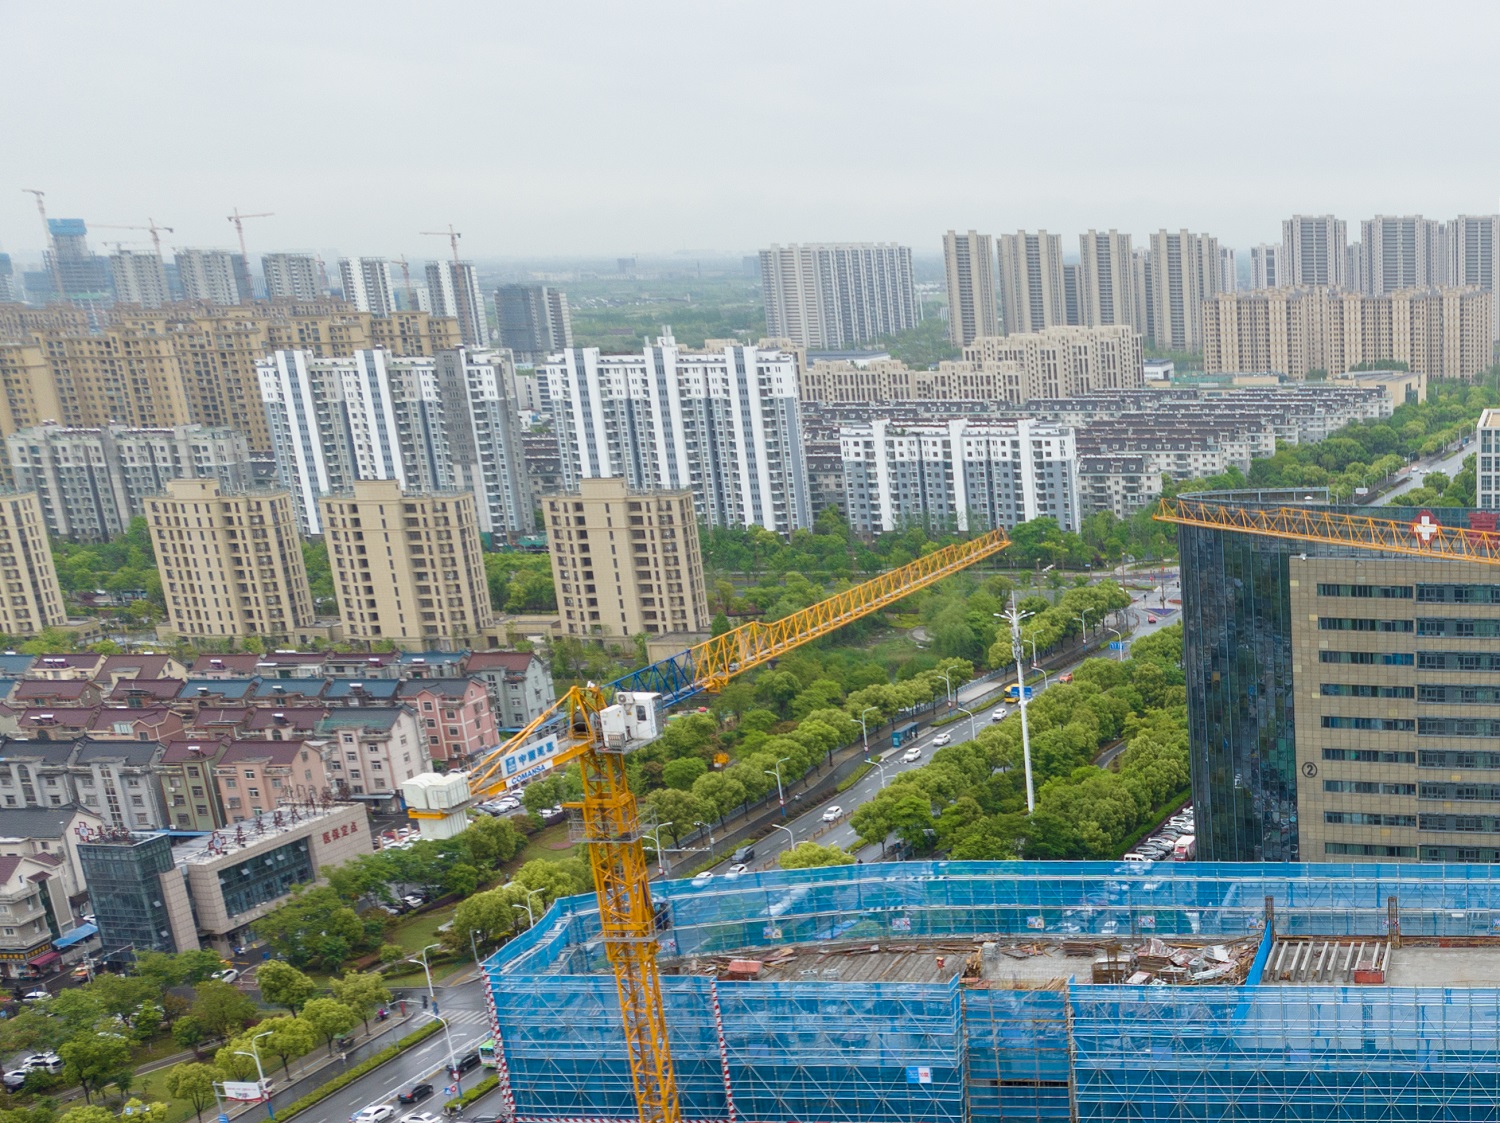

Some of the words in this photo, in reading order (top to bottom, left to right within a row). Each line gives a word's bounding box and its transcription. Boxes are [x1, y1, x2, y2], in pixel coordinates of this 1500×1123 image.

[511, 764, 546, 785] COMANSA
[322, 821, 358, 845] 医保定点
